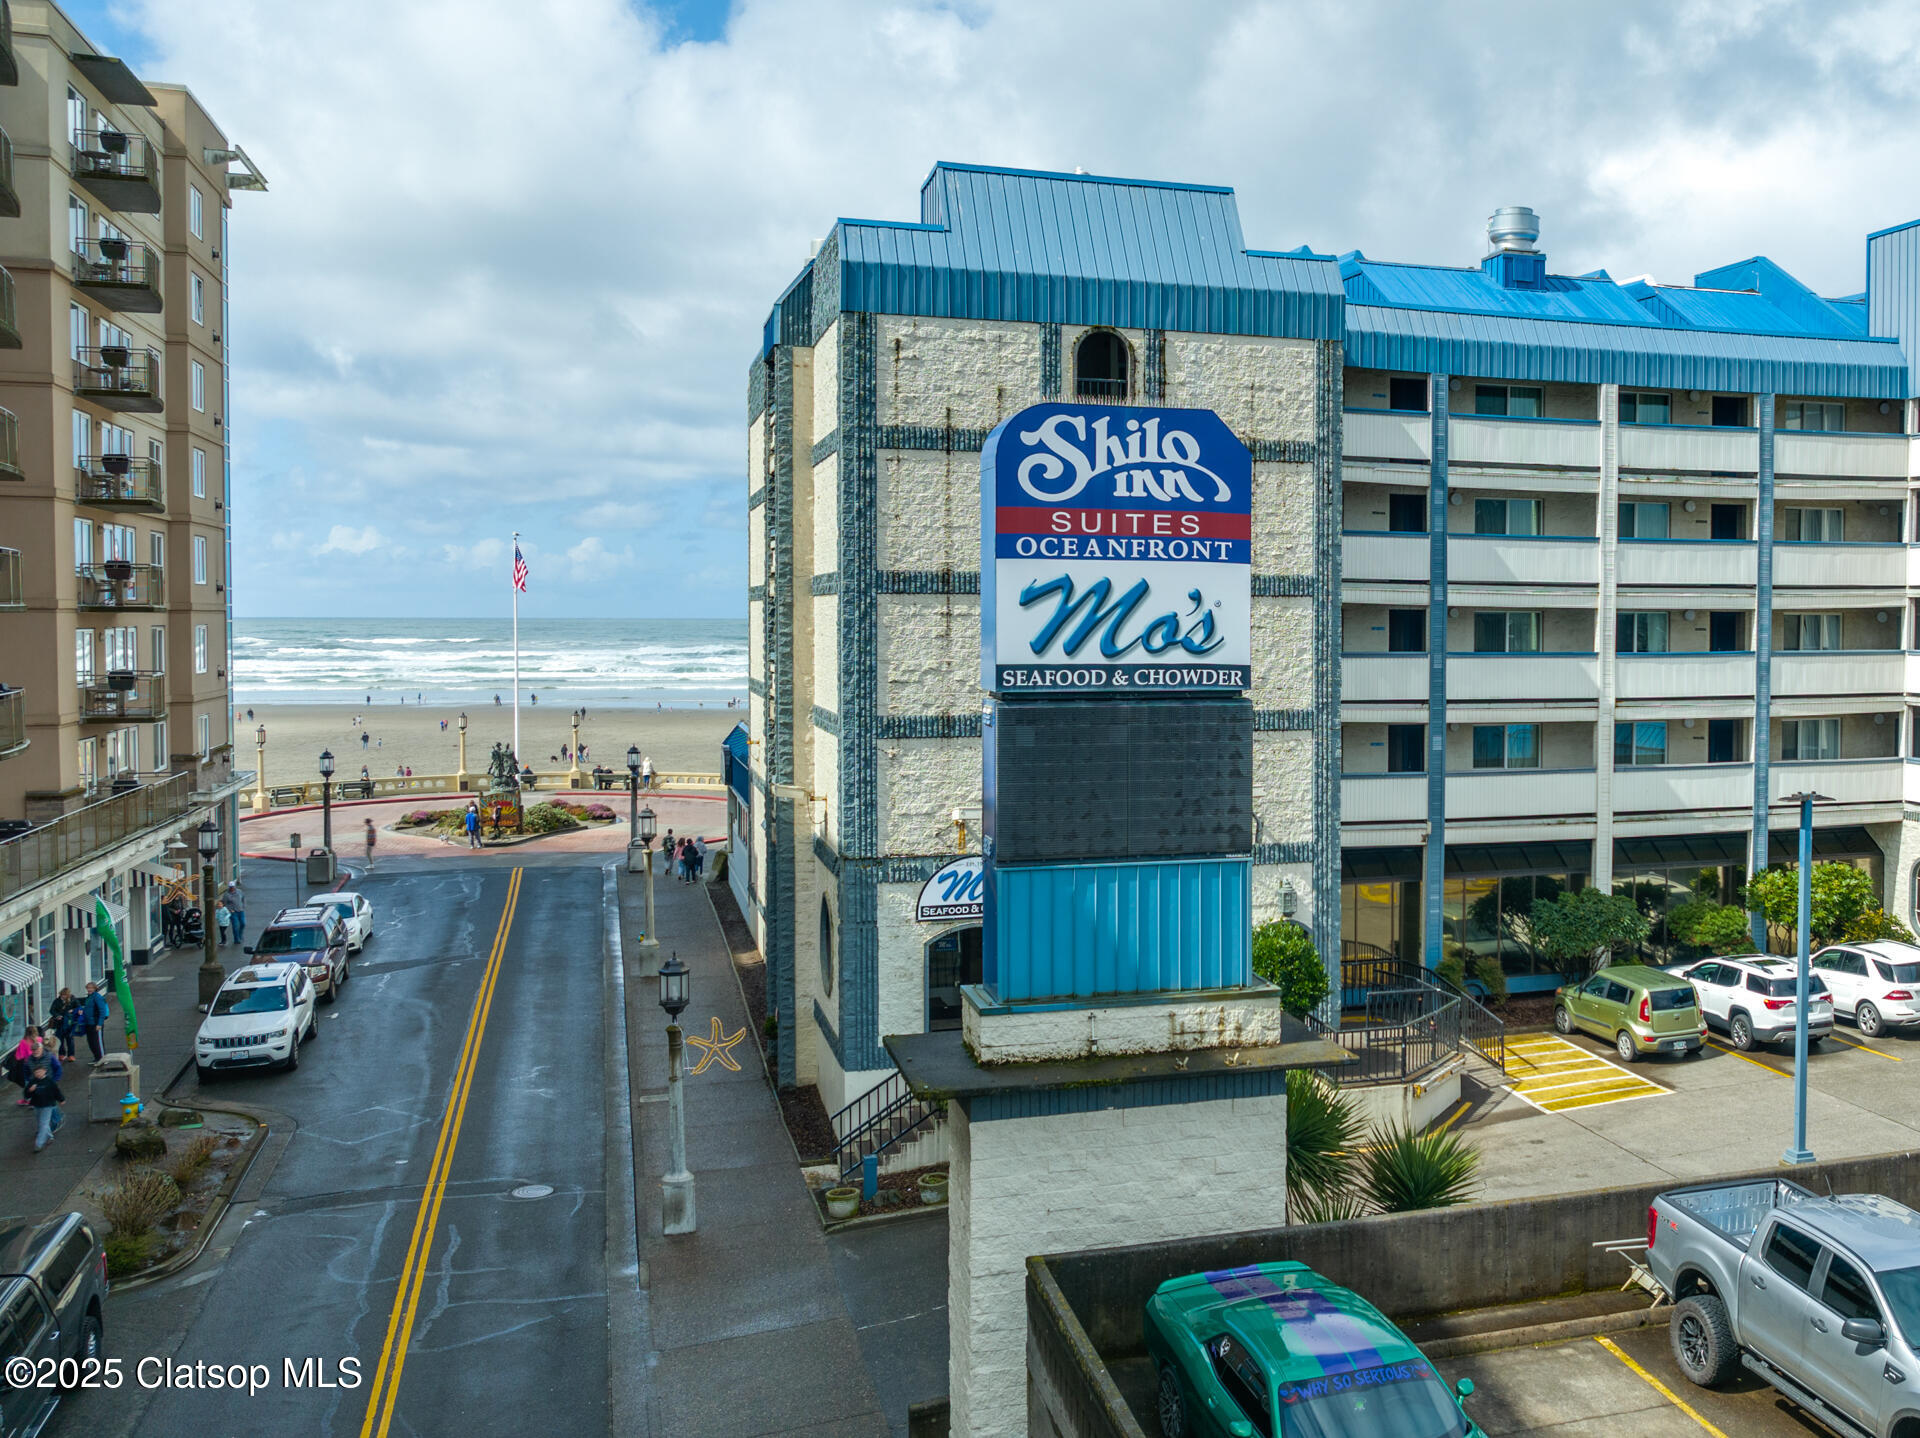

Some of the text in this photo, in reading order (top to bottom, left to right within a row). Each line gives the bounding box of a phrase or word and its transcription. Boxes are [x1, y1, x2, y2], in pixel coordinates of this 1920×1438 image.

[1017, 414, 1232, 502] Shilo
[1051, 511, 1200, 535] SUITES
[1016, 536, 1232, 560] OCEANFRONT
[1019, 573, 1224, 659] Mo's
[1002, 668, 1243, 686] SEAFOOD & CHOWDER
[922, 906, 969, 916] SEAFOOD
[971, 904, 979, 913] &
[1297, 1379, 1329, 1400] WHY
[1332, 1374, 1351, 1391] SO
